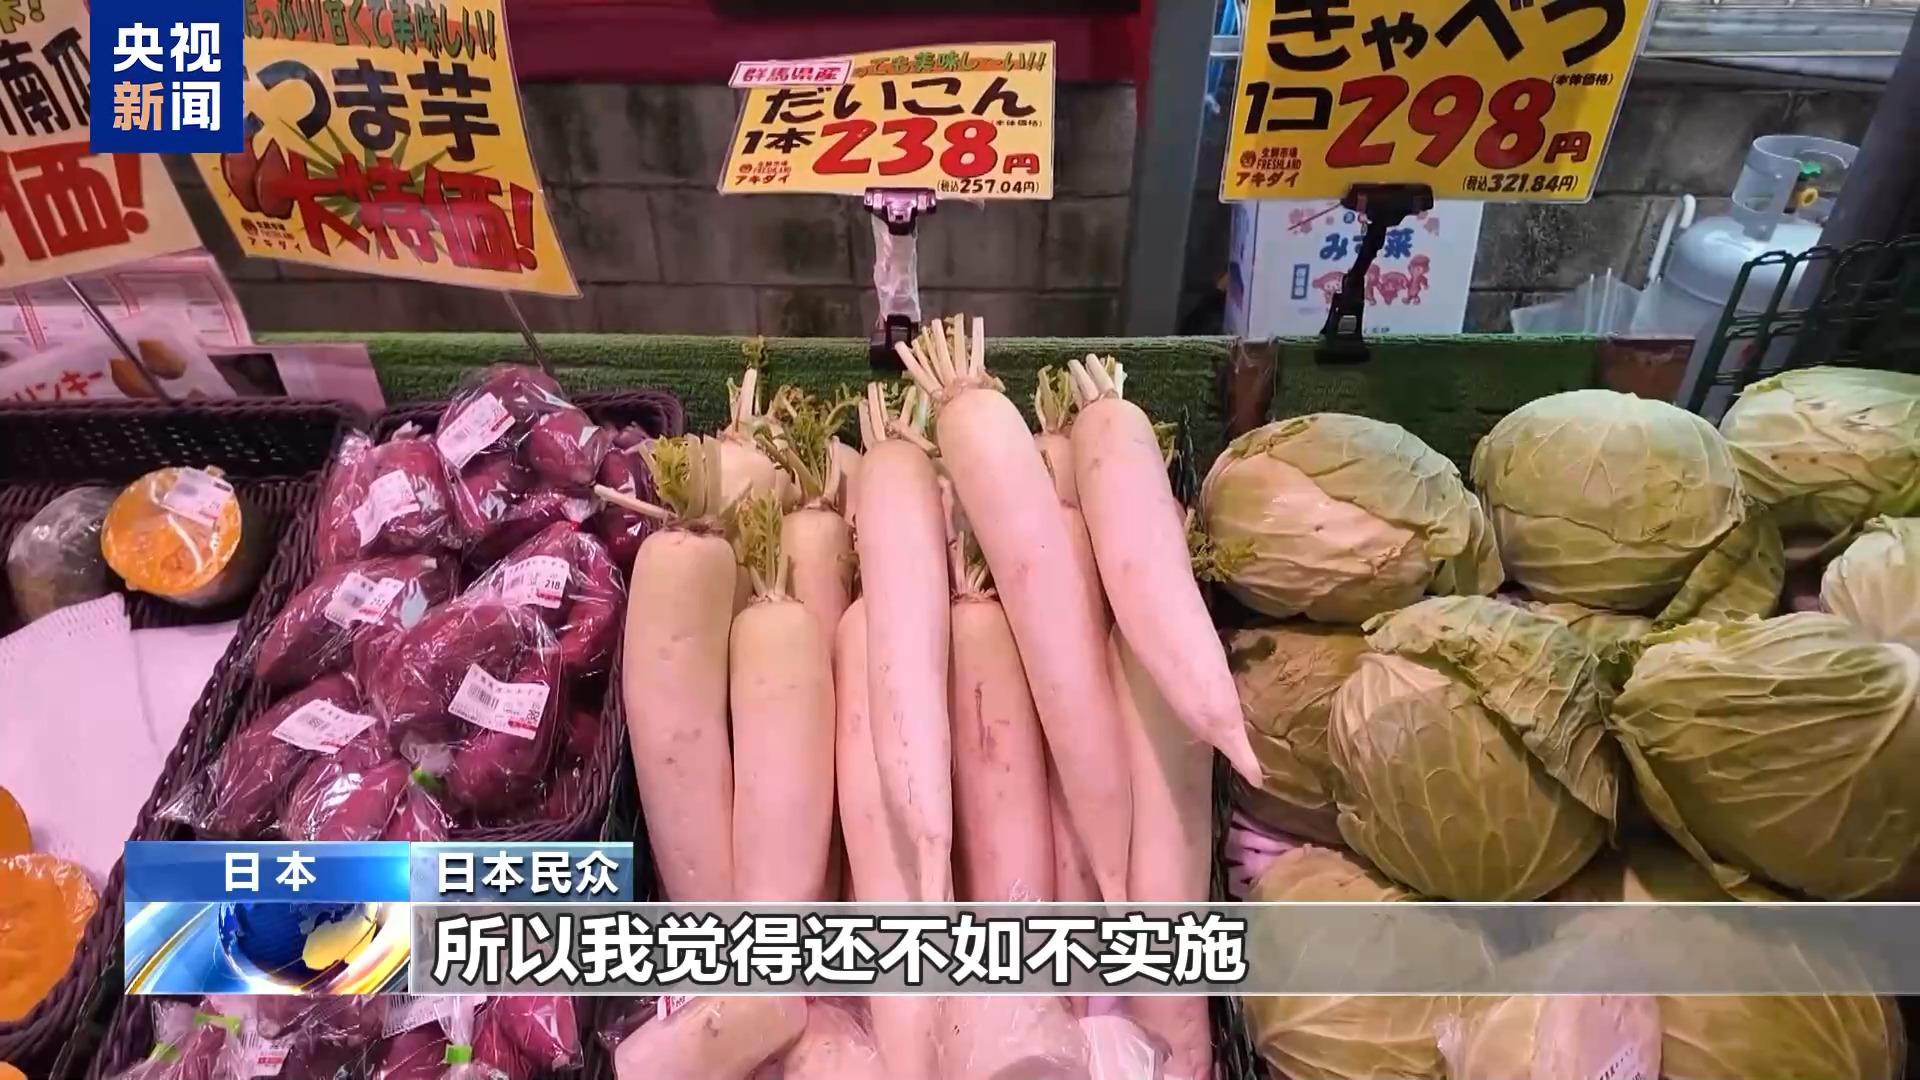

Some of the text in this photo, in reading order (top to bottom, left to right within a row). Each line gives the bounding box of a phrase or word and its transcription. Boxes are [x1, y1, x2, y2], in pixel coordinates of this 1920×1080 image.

[1267, 0, 1626, 71] きゃべつ
[244, 58, 501, 162] つま芋
[760, 77, 1036, 123] だいこん
[284, 150, 538, 274] 大特価!
[1236, 171, 1300, 188] アキダイ
